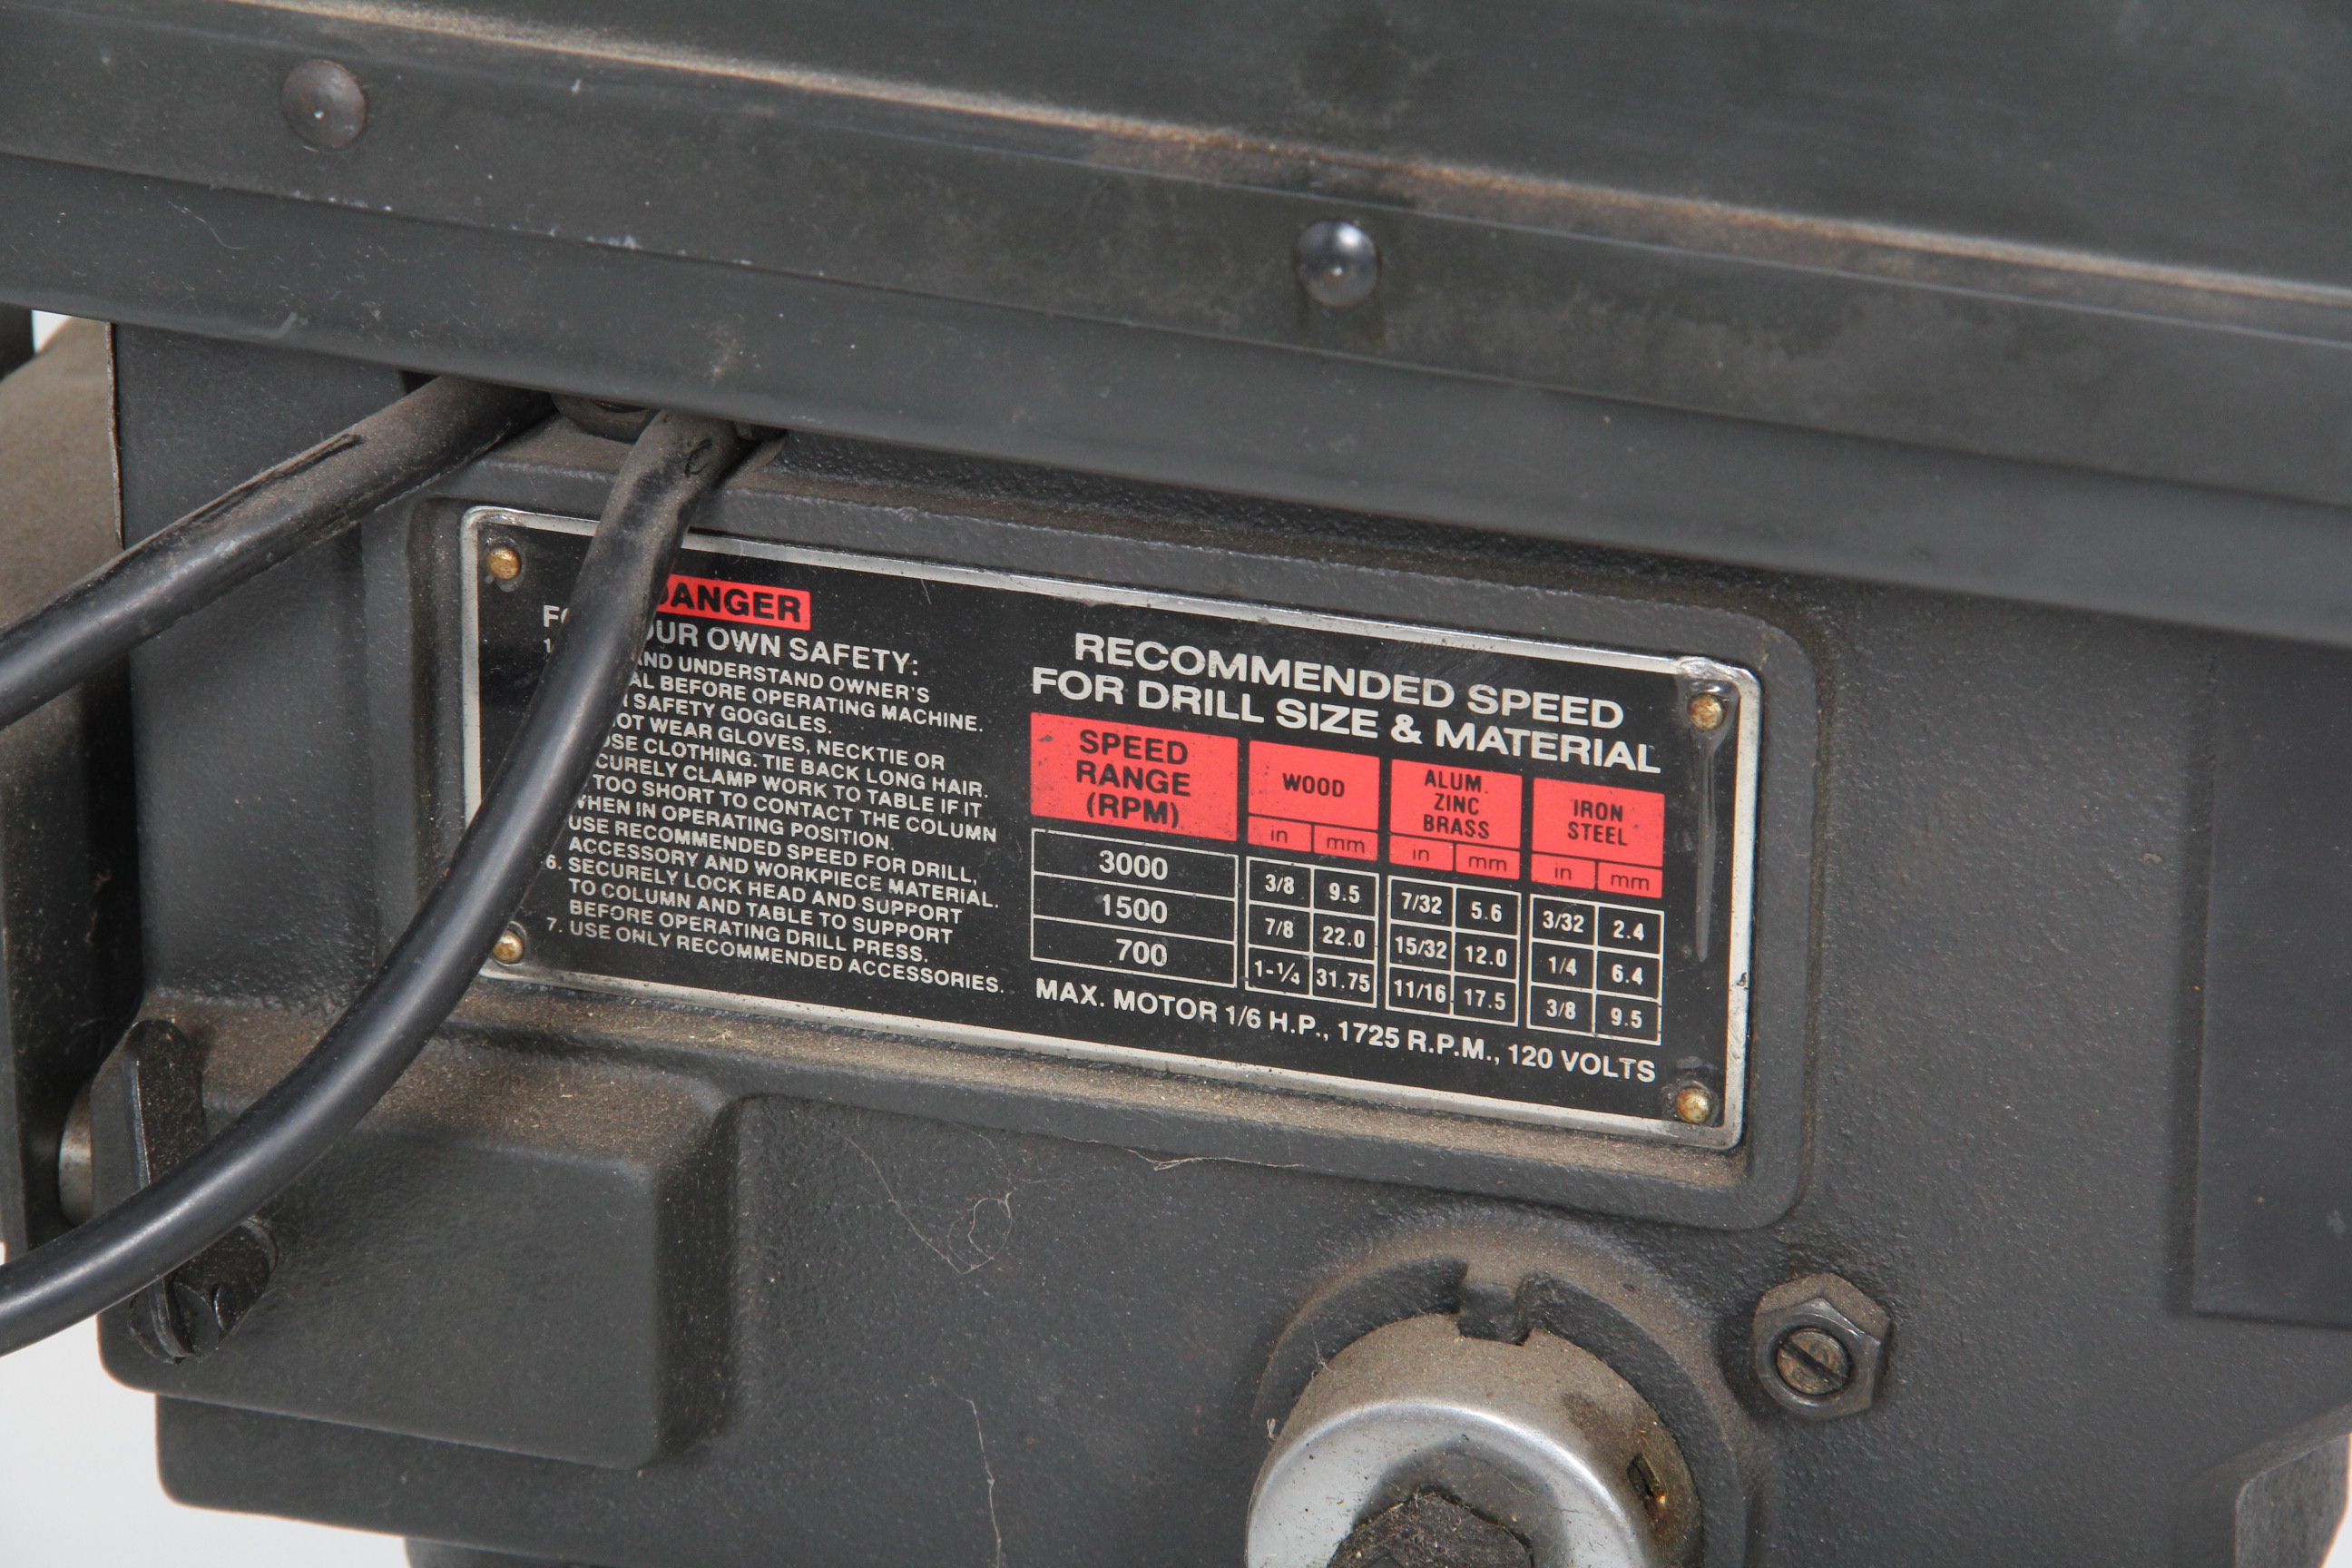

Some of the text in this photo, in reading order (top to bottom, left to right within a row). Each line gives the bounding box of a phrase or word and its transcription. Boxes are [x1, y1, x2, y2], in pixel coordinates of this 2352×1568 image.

[679, 657, 824, 689] UNDERSTAND
[829, 676, 930, 703] OWNER'S
[707, 627, 780, 658] OWN
[789, 638, 918, 676] SAFETY:
[1075, 632, 1623, 729] RECOMMENDED SPEED
[634, 693, 715, 719] SAFETY
[721, 705, 832, 734] GOGGLES.
[661, 676, 746, 701] BEFORE
[752, 688, 875, 718] OPERATING
[882, 704, 983, 732] MACHINE.
[1033, 666, 1661, 773] FOR DRILL SIZE & MATERIAL
[612, 713, 945, 770] OT WEAR GLOVES, NECKTIE OR
[643, 738, 757, 768] CLOTHING.
[763, 753, 795, 773] TIE
[801, 759, 859, 781] BACK
[867, 768, 926, 789] LONG
[932, 777, 988, 798] HAIR.
[1079, 730, 1188, 765] SPEED
[683, 765, 757, 788] CLAMP
[762, 776, 827, 799] WORK
[833, 785, 861, 802] TO
[867, 789, 934, 813] TABLE
[941, 799, 958, 814] IF
[965, 801, 982, 818] IT
[1076, 760, 1191, 797] RANGE
[1282, 773, 1345, 798] WOOD
[1434, 793, 1479, 815] ZINC
[593, 774, 996, 842] TOO SHORT TO CONTACT THE COLUMN
[637, 802, 655, 818] IN
[662, 806, 784, 836] OPERATING
[790, 822, 894, 850] POSITION.
[1087, 792, 1179, 828] (RPM)
[1423, 814, 1489, 839] BRASS
[1568, 821, 1628, 846] STEEL
[1573, 799, 1623, 822] IRON
[569, 815, 977, 886] USE RECOMMENDED SPEED FOR DRILL,
[569, 837, 998, 907] ACCESSORY AND WORKPIECE MATERIAL.
[1270, 828, 1649, 891] in mm in mm in mm
[546, 855, 962, 924] 6. SECURELY LOCK HEAD AND SUPPORT
[569, 877, 953, 944] TO COLUMN AND TABLE TO SUPPORT
[1099, 849, 1644, 941] 3000 3/8 9.5 7/32 5.6 3/32 2.4
[546, 916, 1004, 993] 7. USE ONLY RECOMMENDED ACCESSORIES.
[569, 899, 927, 962] BEFORE OPERATING DRILL PRESS.
[1102, 894, 1642, 985] 1500 7/8 22.0 15/32 12.0 1/4 6.4
[1115, 938, 1168, 966] 700
[1316, 968, 1371, 993] 31.75
[1395, 979, 1446, 1004] 11/16
[1465, 988, 1506, 1011] 17.5
[1546, 999, 1576, 1021] 3/8
[1610, 1007, 1642, 1029] 9.5
[1036, 978, 1656, 1083] MAX. MOTOR 1/6 H.P., 1725 R.P.M., 120 VOLTS
